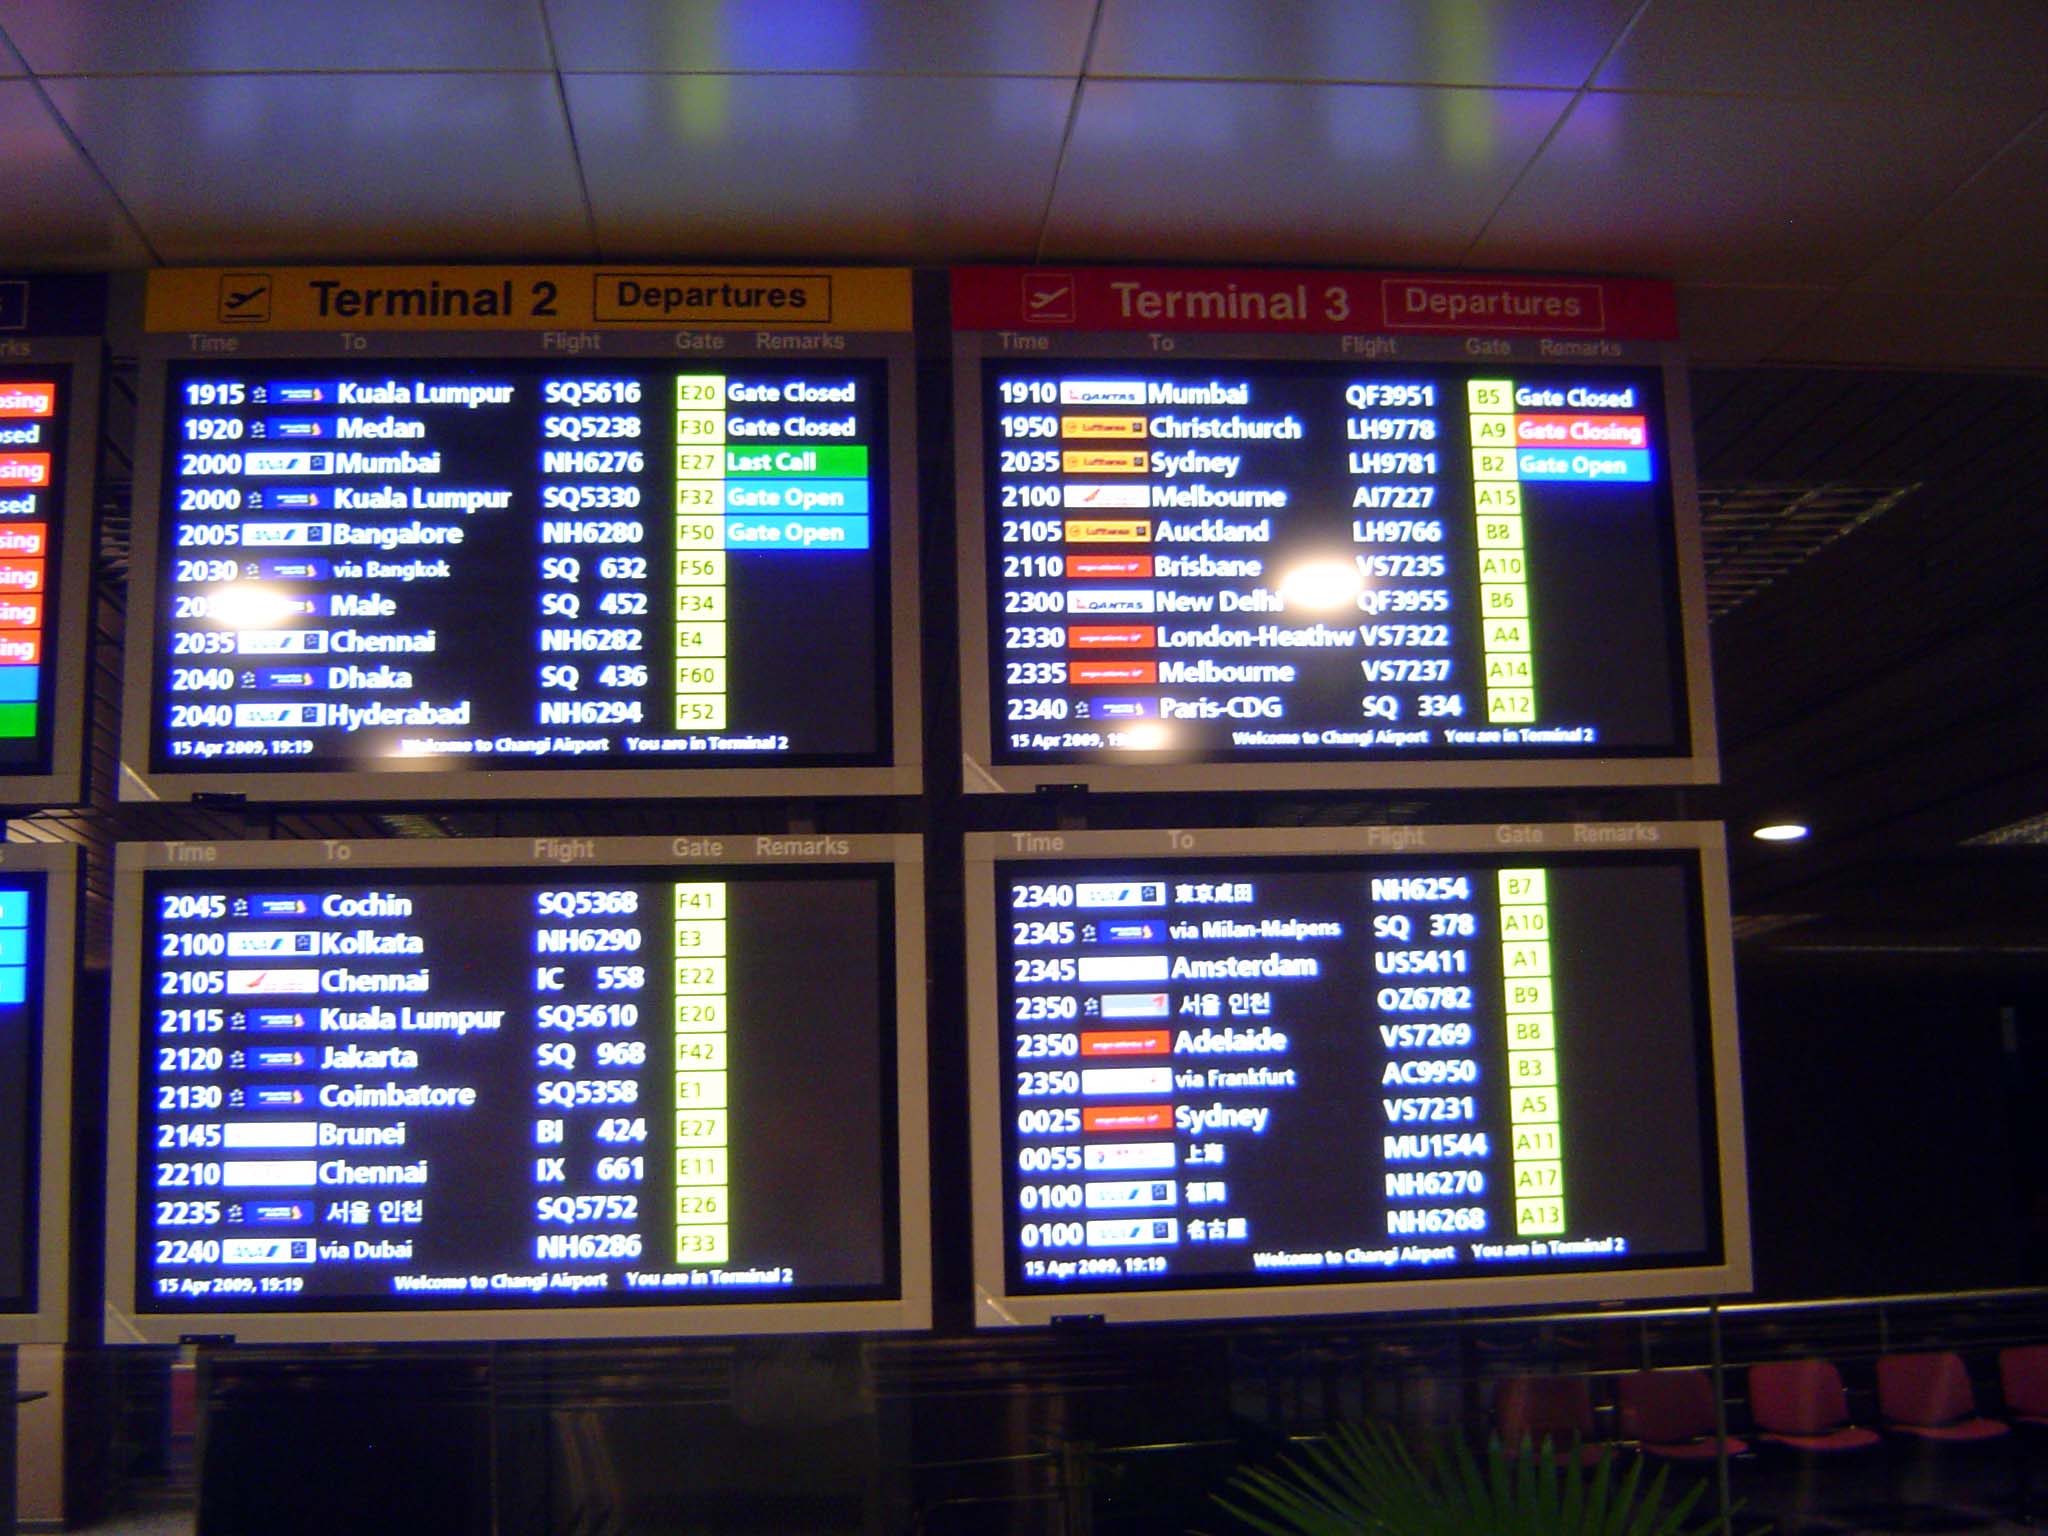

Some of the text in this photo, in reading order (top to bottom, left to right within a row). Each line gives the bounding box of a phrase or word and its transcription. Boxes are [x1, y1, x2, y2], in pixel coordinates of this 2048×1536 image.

[309, 281, 807, 317] Terminal 2 Departures
[1110, 282, 1580, 321] Terminal 3 Departures
[190, 332, 844, 352] Time To Flight Gate Remarks
[1000, 332, 1622, 356] Time To Flight Gate Remarks
[0, 391, 48, 413] sing
[186, 381, 855, 408] 1915 Kuala Lumpur SQ5616 E20 Gate Closed
[1001, 383, 1056, 404] 1910
[1148, 382, 1248, 404] Mumbai
[1346, 386, 1434, 409] QF3951
[1476, 389, 1501, 405] B5
[1516, 389, 1563, 407] Gate
[1567, 389, 1632, 408] Closed
[186, 417, 856, 441] 1920 Medan SQ5238 F30 Gate Closed
[1001, 417, 1058, 438] 1950
[1150, 416, 1302, 439] Christchurch
[1347, 420, 1435, 440] LH9778
[1480, 422, 1506, 439] A9
[1518, 423, 1566, 441] Gate
[1570, 422, 1642, 444] Closing
[0, 461, 44, 482] sing
[182, 452, 816, 475] 2000 Mumbai NH6276 E27 Last Call
[1001, 451, 1626, 478] 2035 Sydney LH9781 B2 Gate Open
[181, 486, 844, 513] 2000 Kuala Lumpur SQ5330 F32 Gate Open
[179, 522, 844, 549] 2005 Bangalore NH6280 F50 Gate Open
[177, 558, 715, 582] 2030 via Bangkok SQ 632 F56
[174, 629, 703, 653] 2035 Chennai NH6282 E4
[1006, 626, 1520, 648] 2330 London-Heathw VS7322 A4
[1008, 695, 1531, 720] 2340 Paris-CDG SQ 334 A12
[164, 838, 849, 862] Time To Flight Gate Remarks
[1012, 826, 1659, 851] Time To Flight Gate Remarks
[164, 891, 714, 918] 2045 Cochin SQ5368 F41
[162, 929, 702, 956] 2100 Kolkata NH6290 E3
[1014, 950, 1538, 982] 2345 Amsterdam US5411 A1
[1016, 986, 1539, 1019] 2350 서울 인천 OZ6782 B9
[1017, 1023, 1541, 1057] 2350 Adelaide VS7269 B8
[159, 1042, 715, 1071] 2120 Jakarta SQ 968 F42
[159, 1081, 702, 1109] 2130 Coimbatore SQ5358 E1
[1018, 1096, 1548, 1134] 0025 Sydney VS7231 A5
[158, 1119, 716, 1148] 2145 Brunei BI 424 E27
[157, 1196, 717, 1224] 2235 서울 인천 SQ5752 E26
[395, 1275, 467, 1290] Welcome
[470, 1276, 489, 1289] to
[491, 1273, 548, 1291] Changi
[550, 1272, 608, 1290] Airport
[626, 1271, 661, 1286] You
[710, 1268, 781, 1284] Terminal
[782, 1268, 794, 1283] 2
